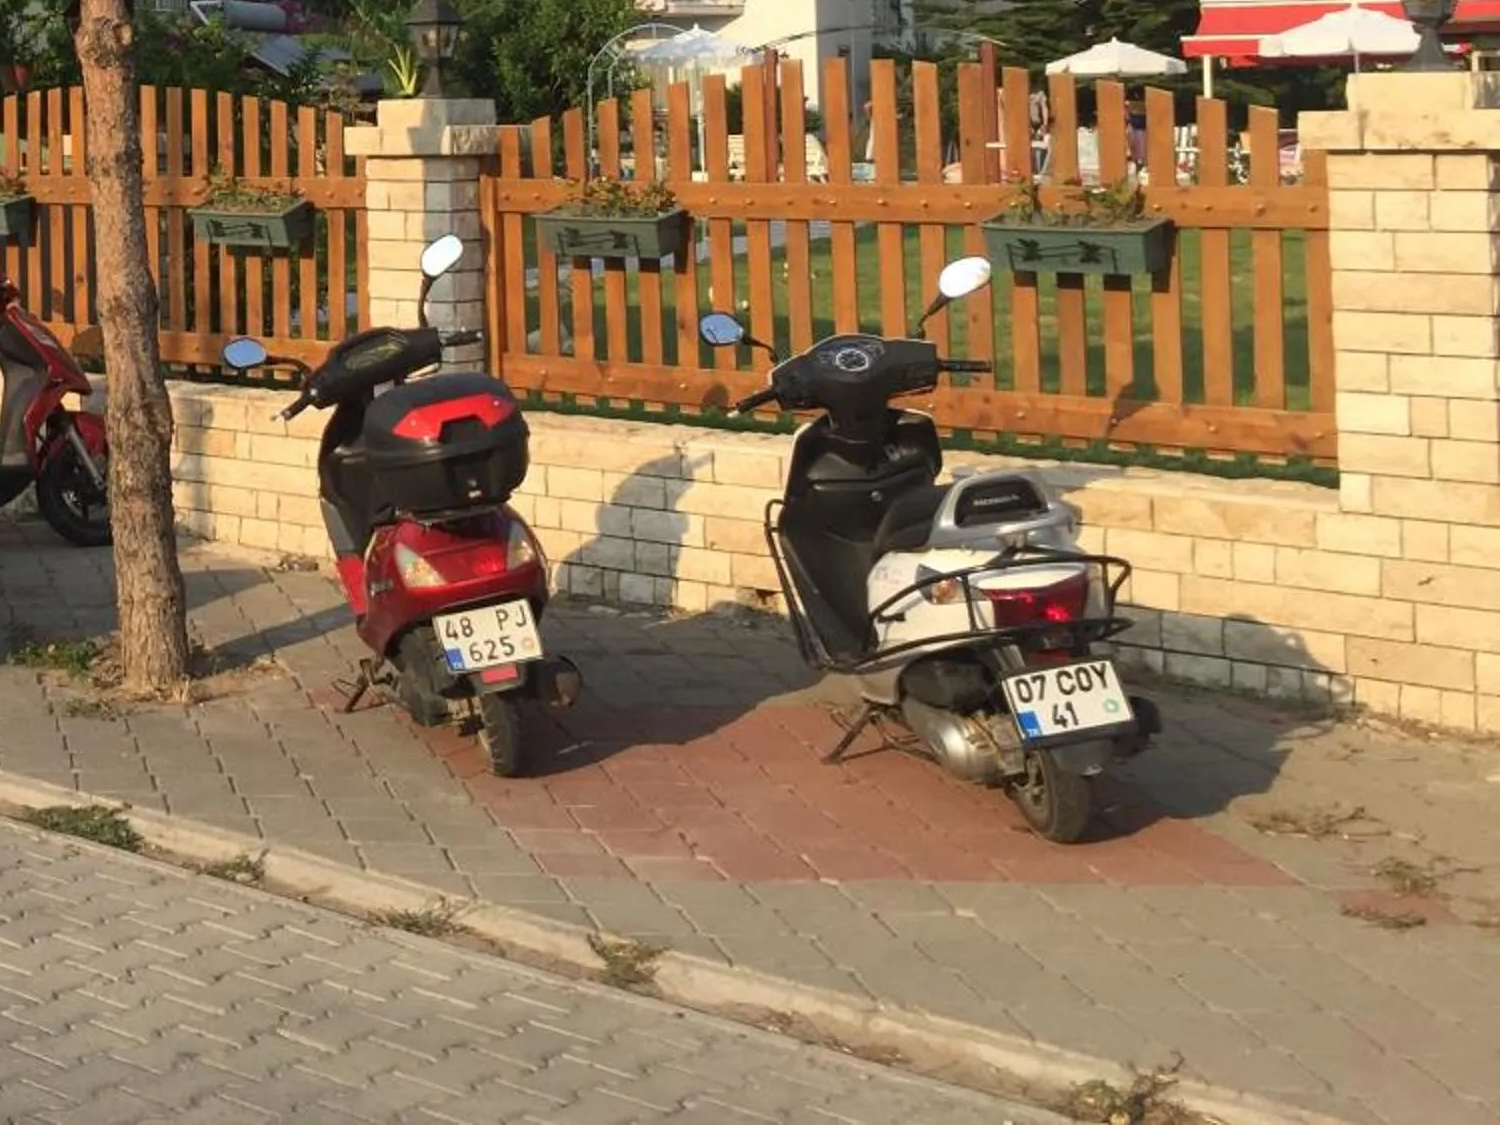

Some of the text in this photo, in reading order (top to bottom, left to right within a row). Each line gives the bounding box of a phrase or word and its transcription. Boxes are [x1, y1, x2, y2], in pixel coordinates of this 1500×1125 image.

[445, 605, 527, 640] 48 PJ
[469, 635, 515, 662] 625
[1015, 674, 1046, 704] 07
[1051, 701, 1079, 728] 41
